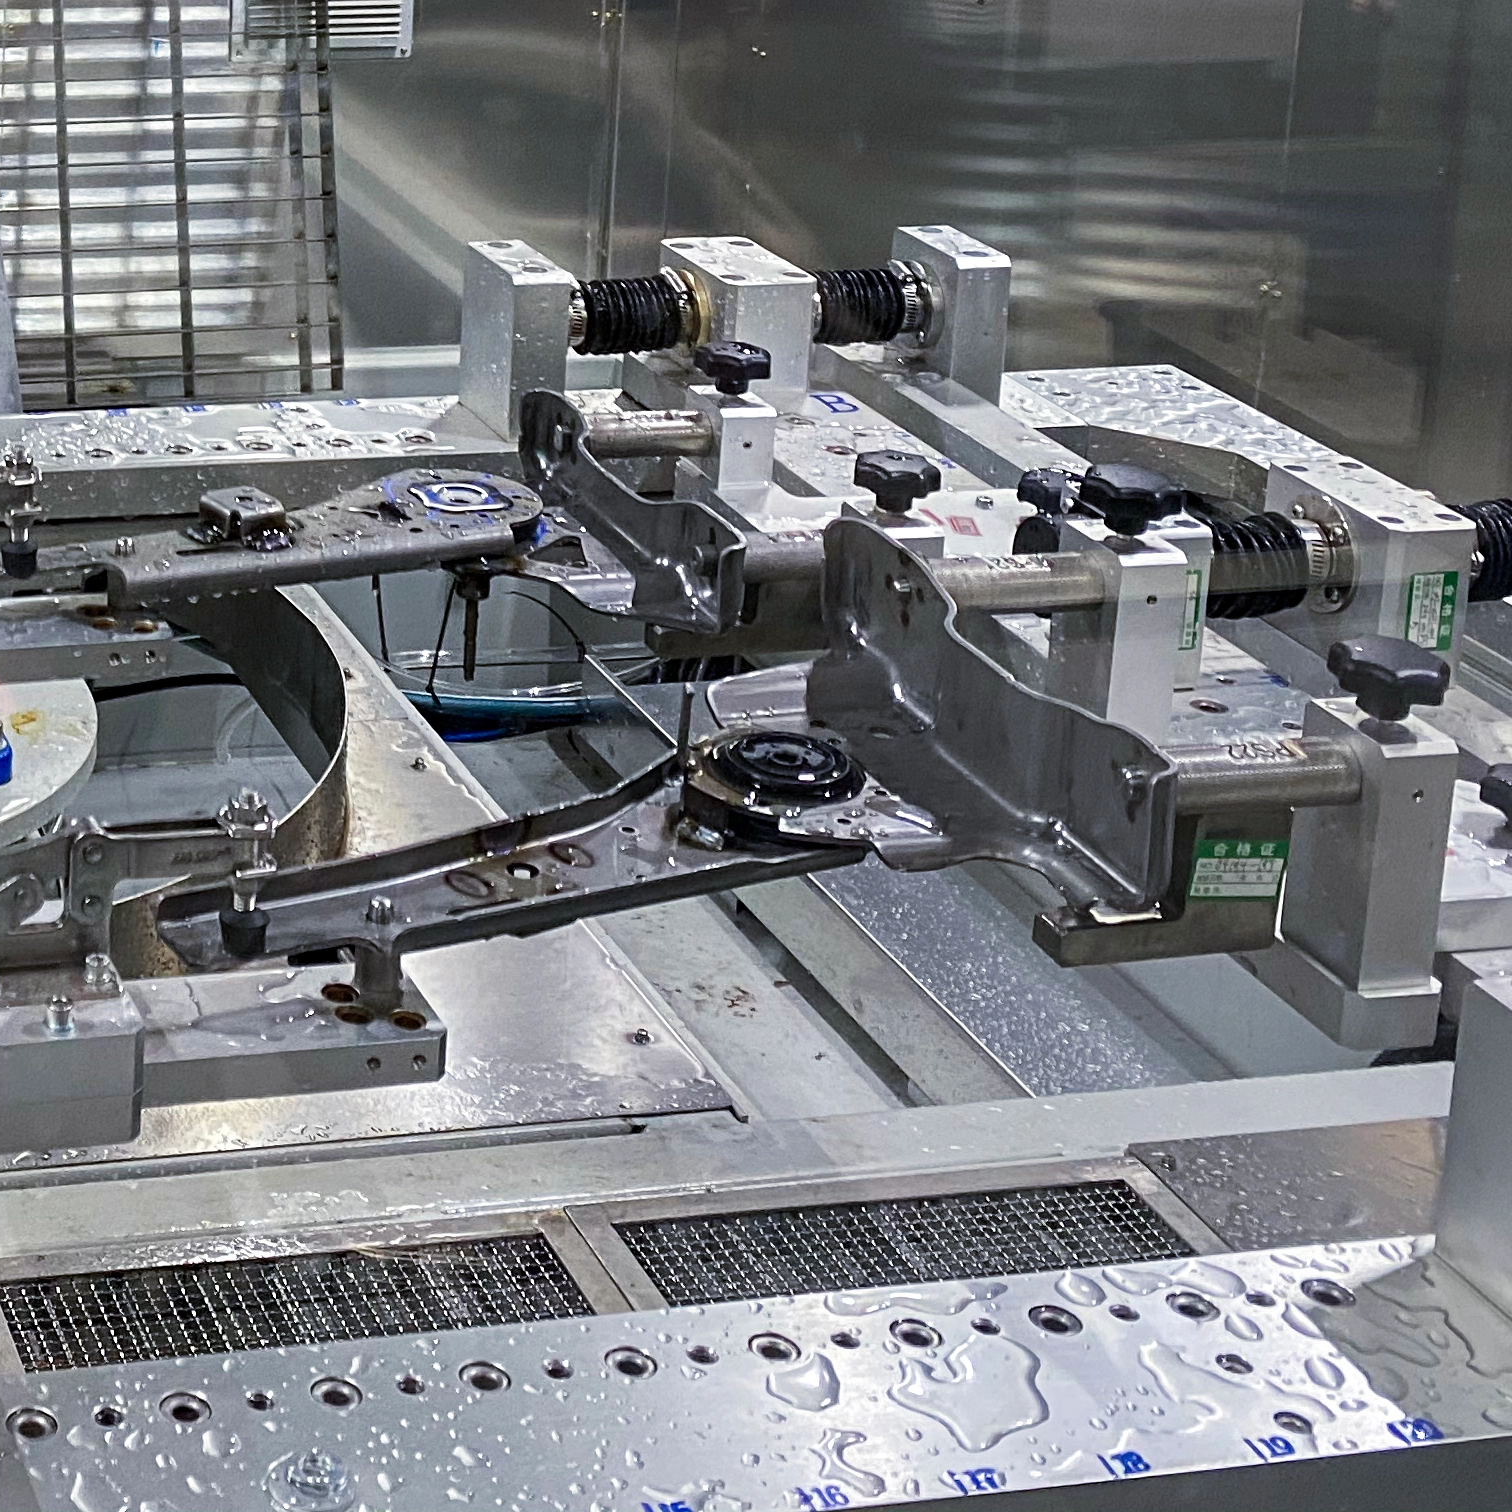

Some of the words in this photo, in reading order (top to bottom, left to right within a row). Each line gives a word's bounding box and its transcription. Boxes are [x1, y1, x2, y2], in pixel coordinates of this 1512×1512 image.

[809, 394, 860, 414] B
[1214, 841, 1275, 856] 合格证
